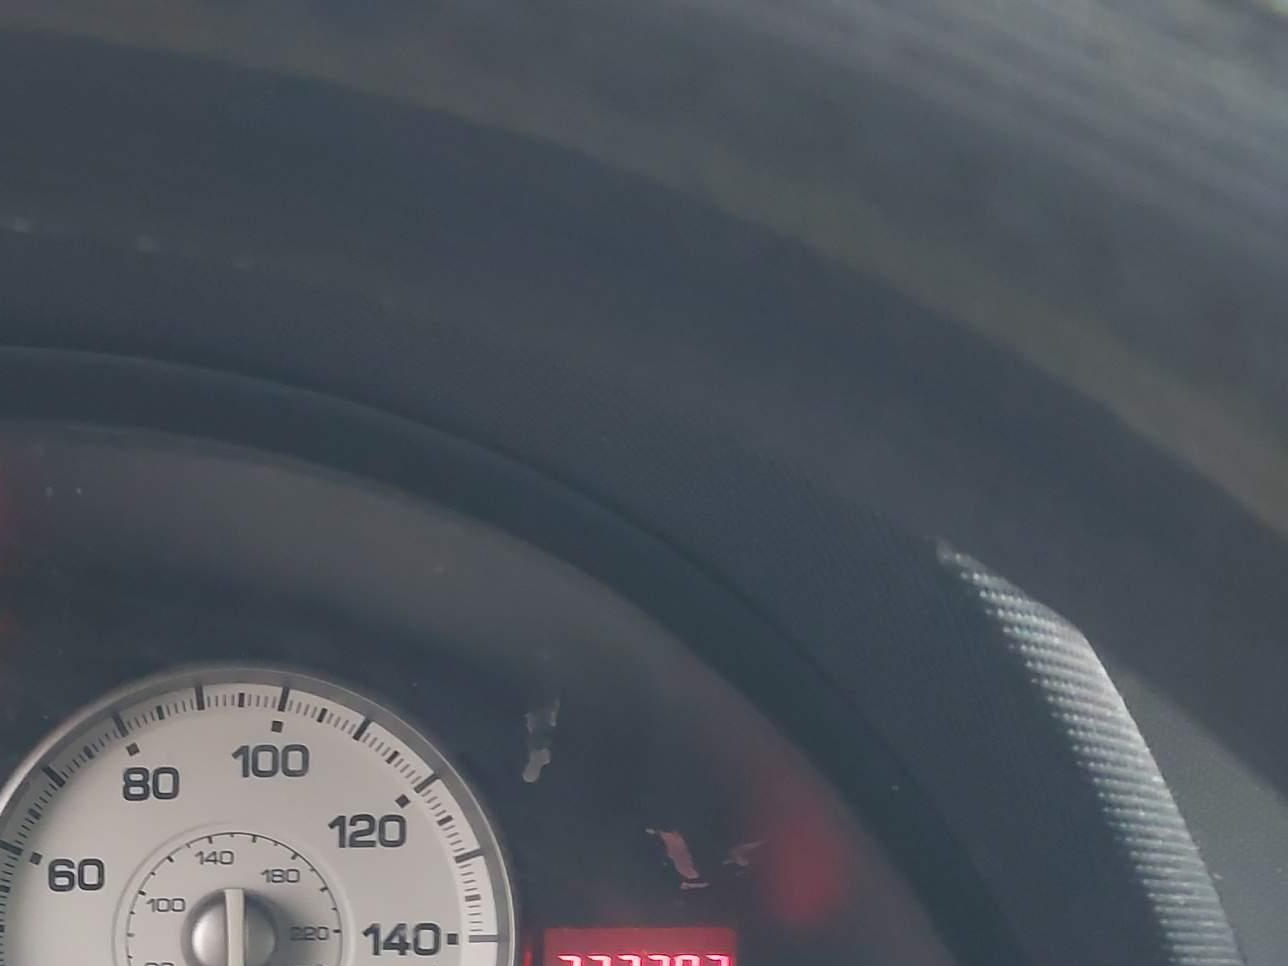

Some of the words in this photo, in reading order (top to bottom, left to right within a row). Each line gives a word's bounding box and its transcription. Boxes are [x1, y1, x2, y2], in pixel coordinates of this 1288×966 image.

[232, 744, 309, 778] 100
[122, 767, 180, 801] 80
[328, 814, 407, 849] 120
[48, 858, 105, 892] 60
[195, 850, 234, 866] 140
[261, 868, 300, 883] 180
[147, 898, 186, 913] 100
[290, 926, 330, 941] 220
[362, 923, 441, 957] 140
